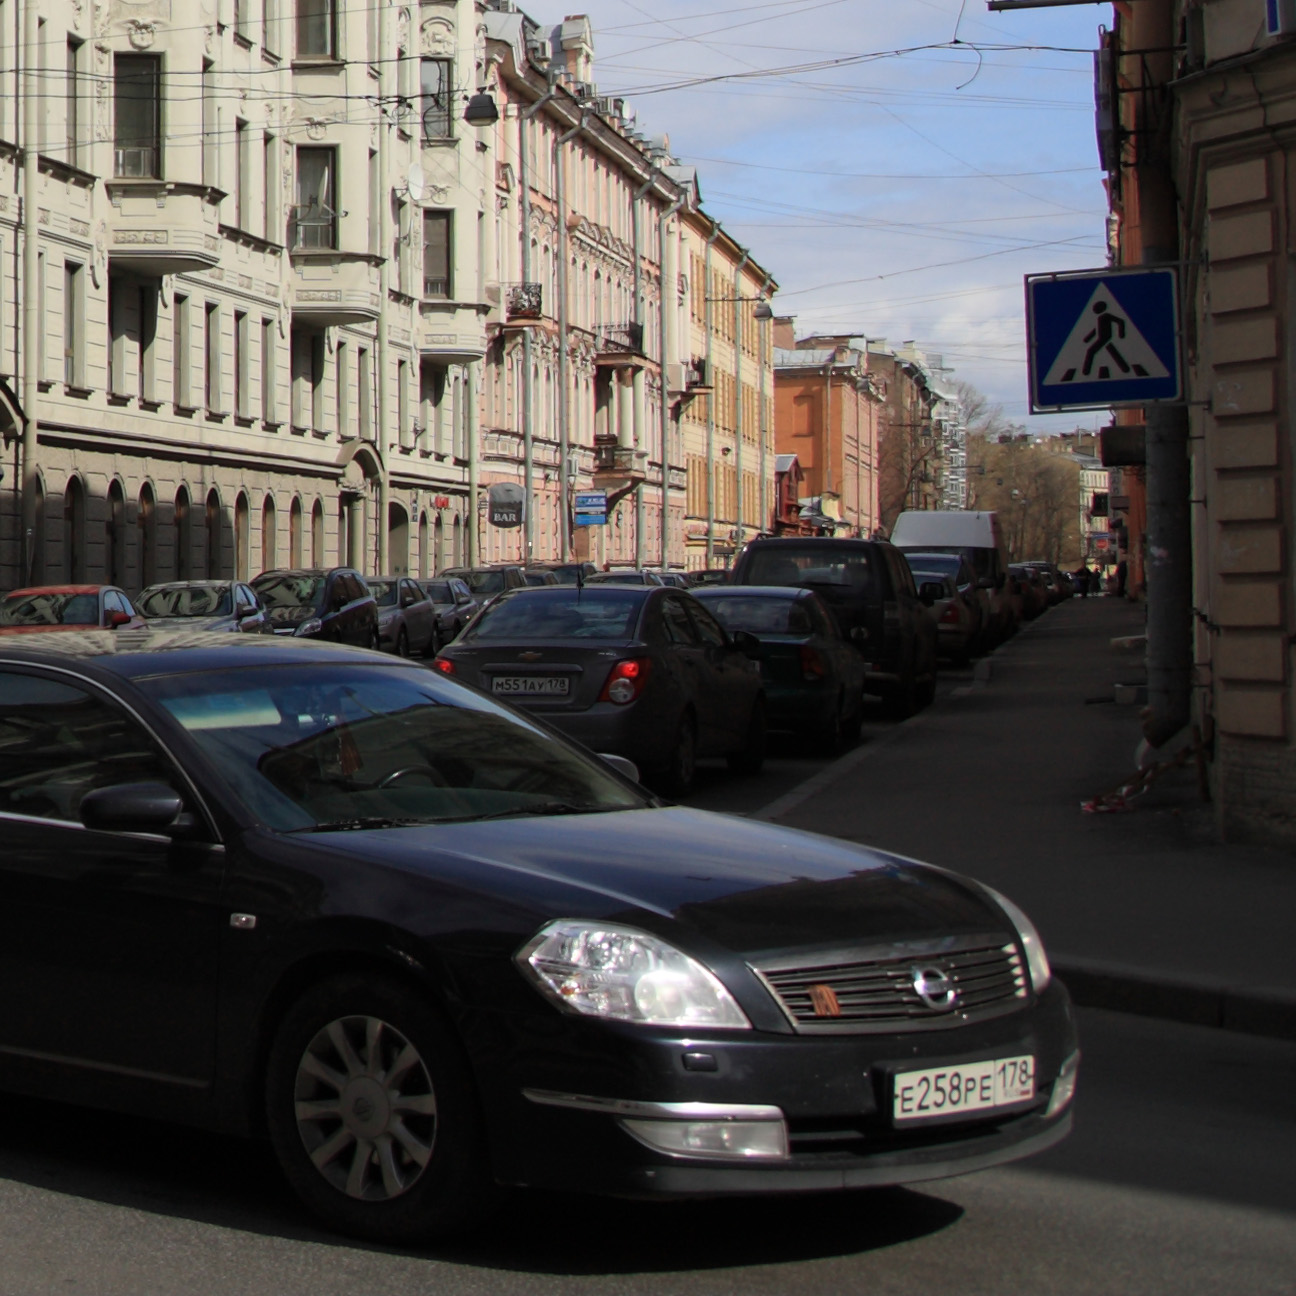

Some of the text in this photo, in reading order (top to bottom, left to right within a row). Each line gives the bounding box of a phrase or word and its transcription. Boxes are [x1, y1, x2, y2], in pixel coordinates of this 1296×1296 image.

[493, 513, 516, 522] BAR
[547, 678, 566, 689] 178
[998, 1060, 1029, 1089] 178
